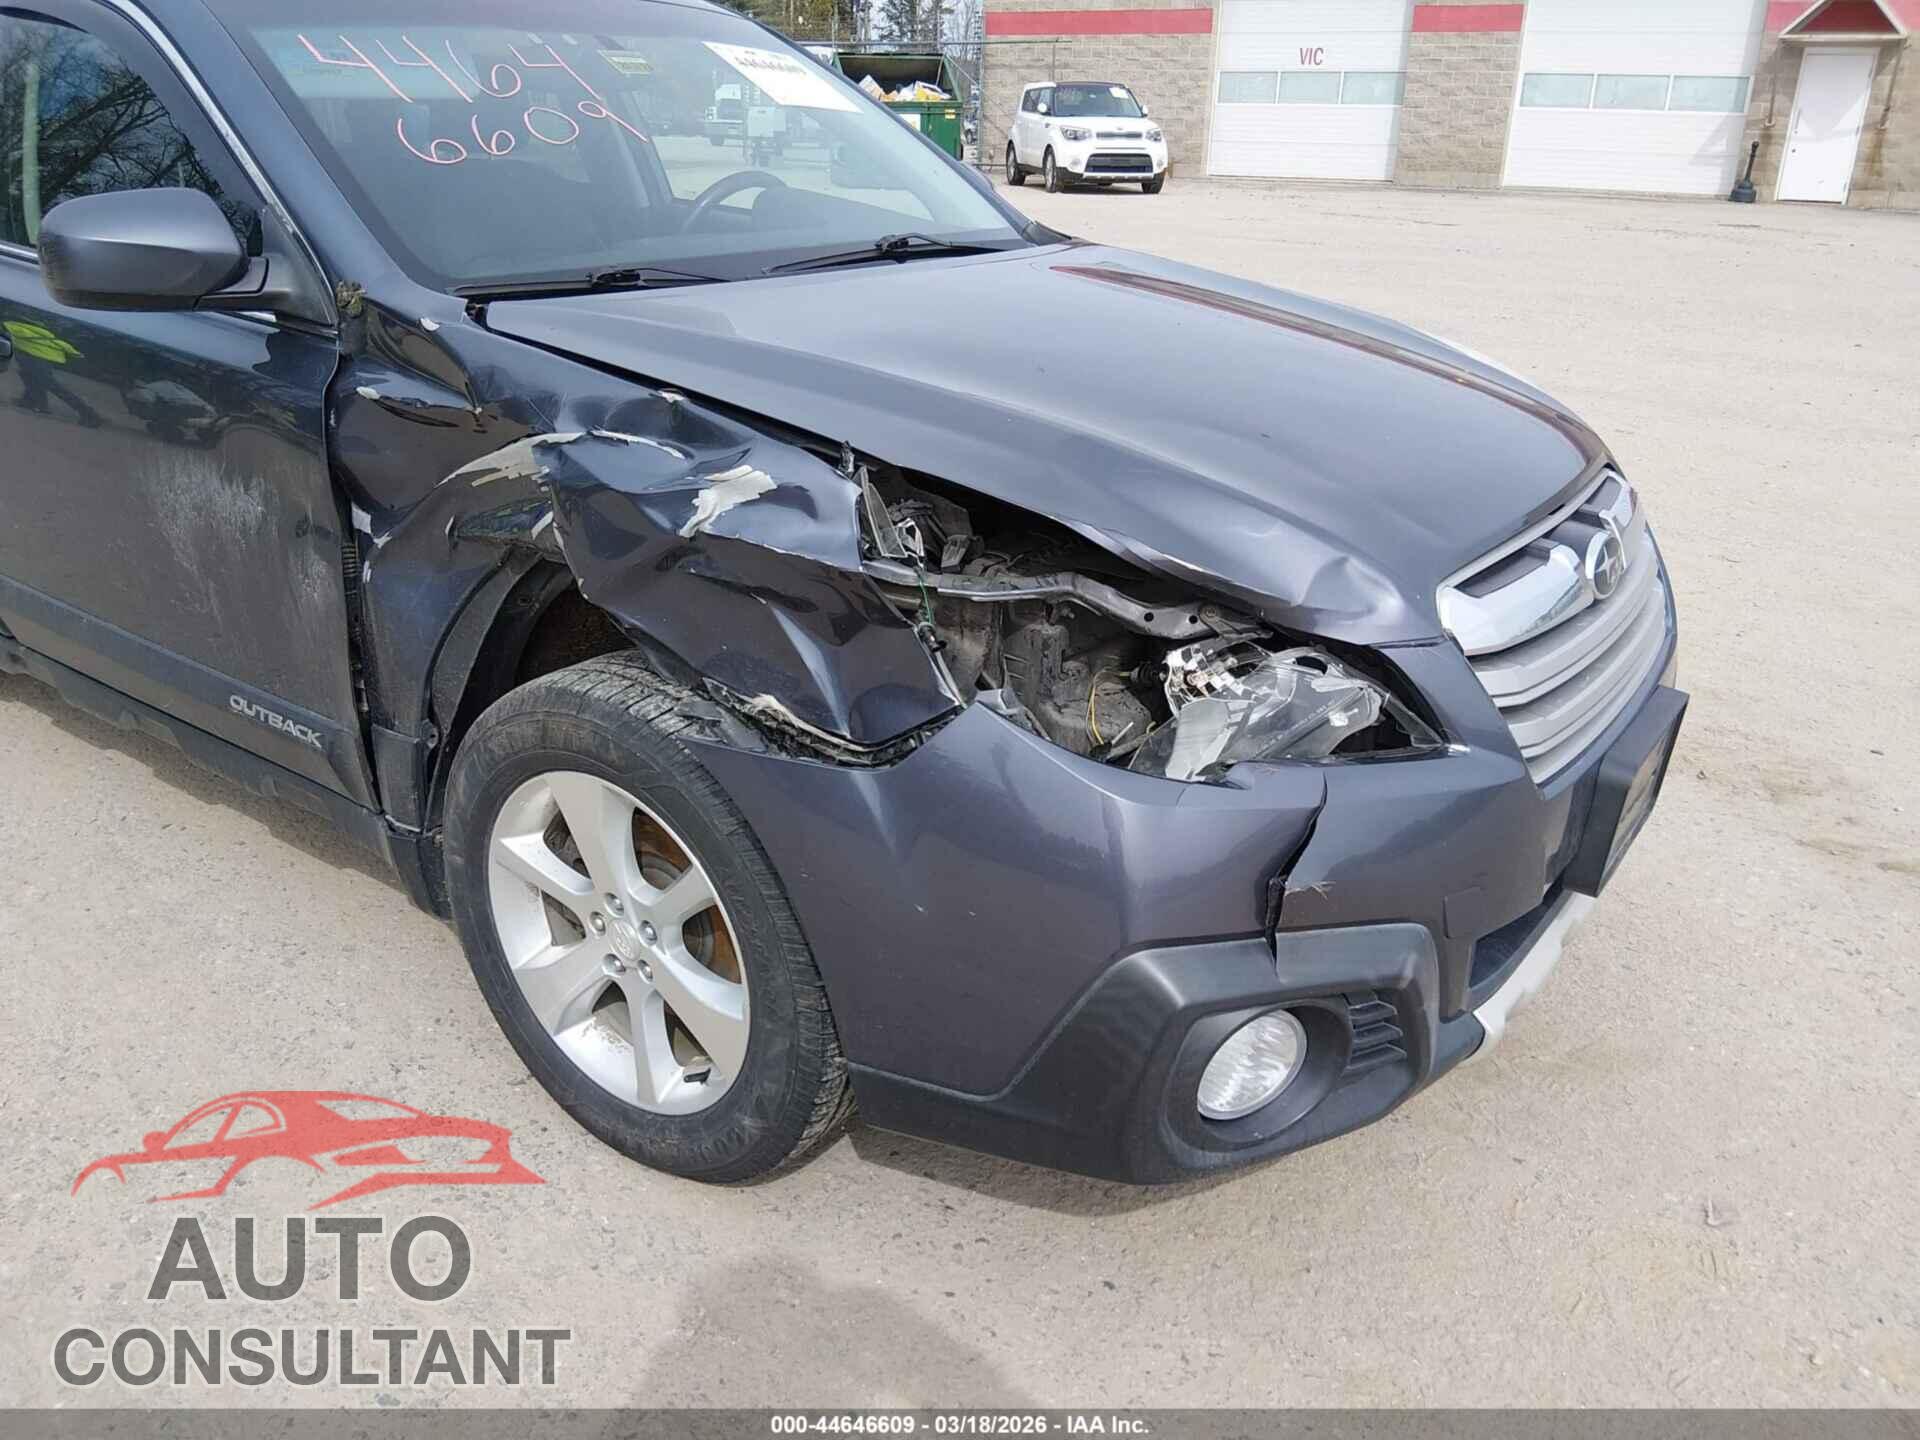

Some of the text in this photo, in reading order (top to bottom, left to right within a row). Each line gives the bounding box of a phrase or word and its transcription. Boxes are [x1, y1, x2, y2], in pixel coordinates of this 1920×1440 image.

[298, 33, 605, 104] 4464
[1299, 47, 1325, 66] VIC
[395, 99, 650, 165] 6609
[229, 694, 323, 749] OUTBACK
